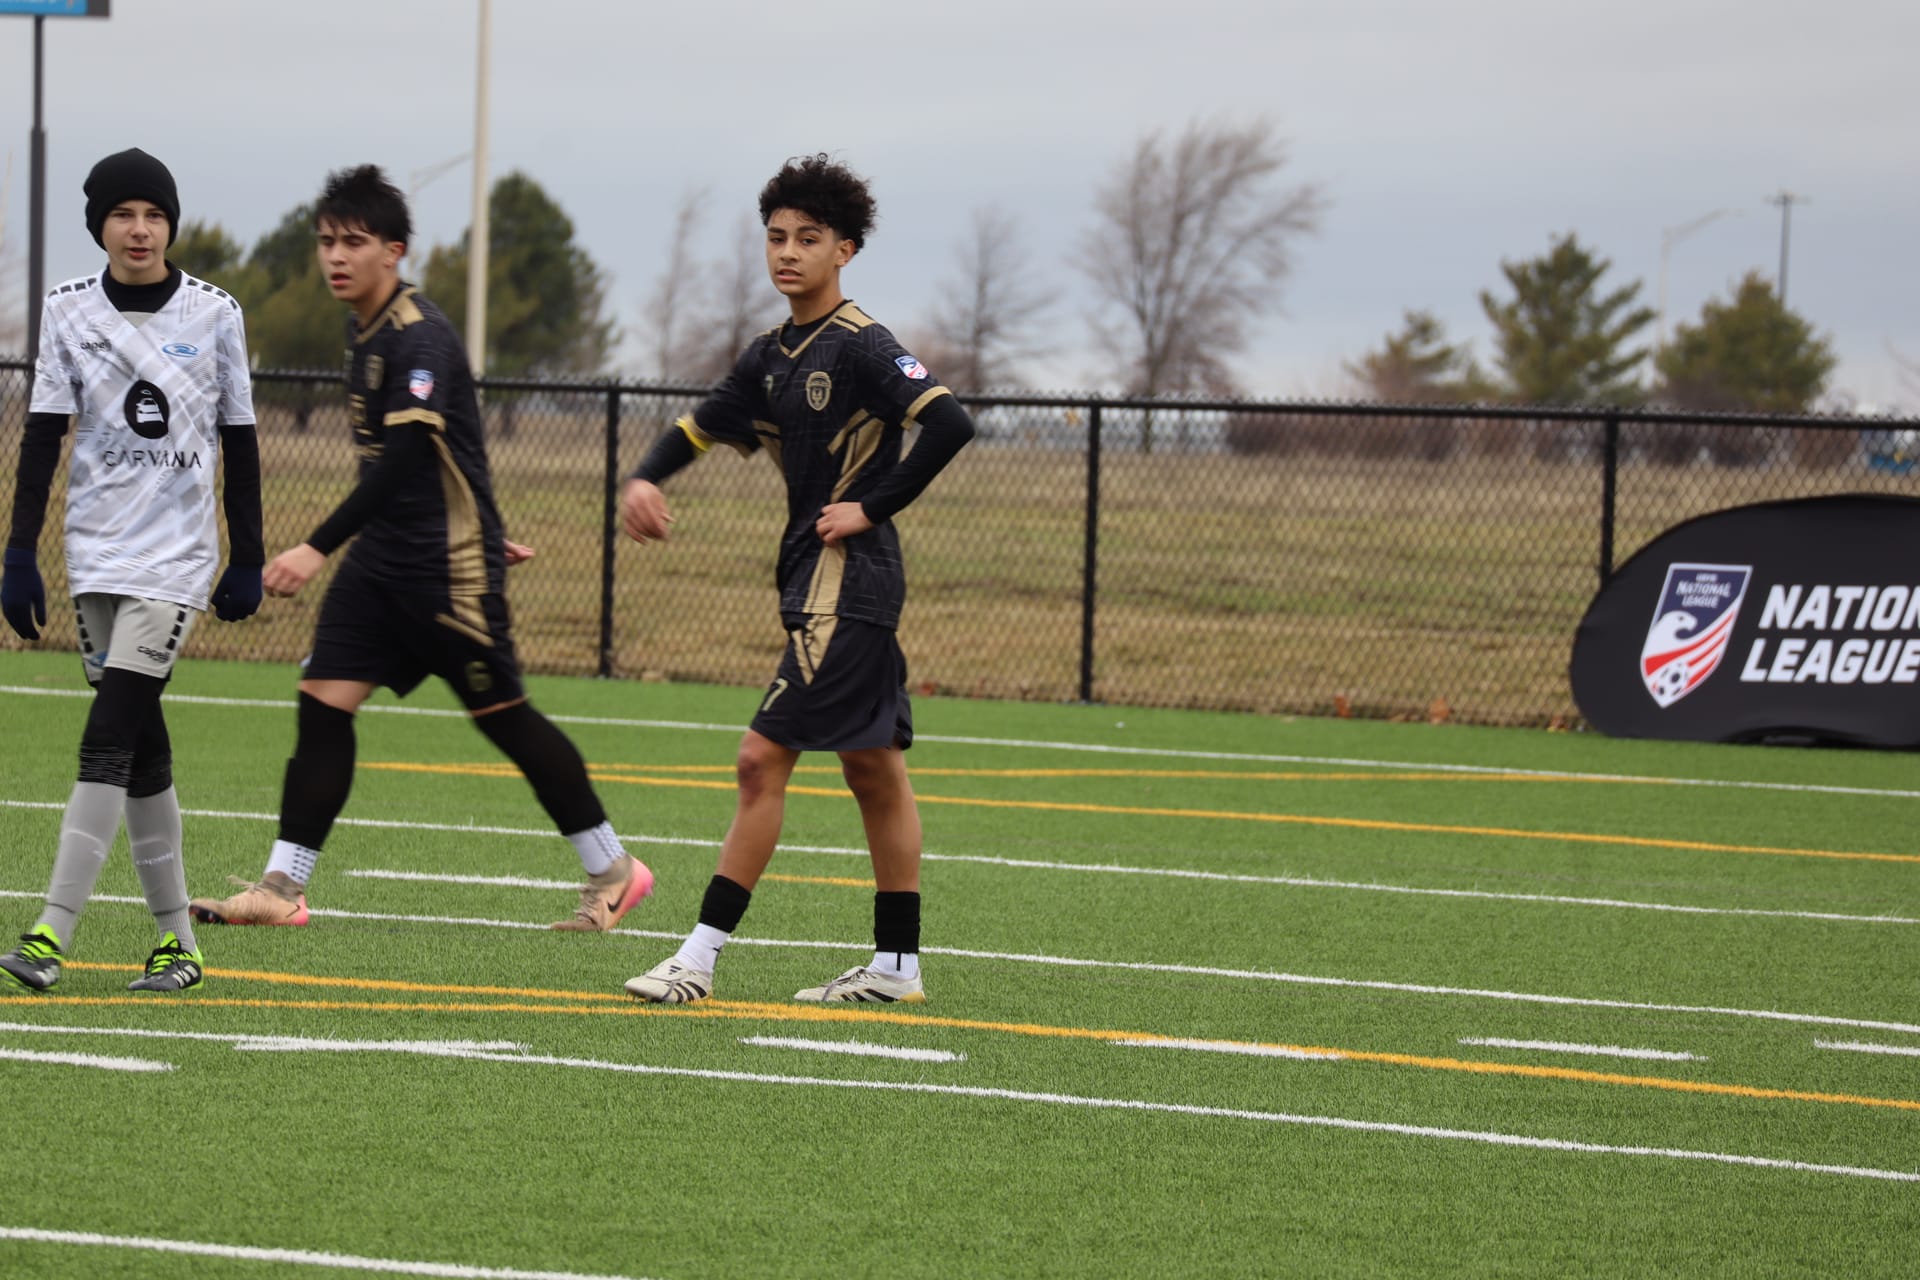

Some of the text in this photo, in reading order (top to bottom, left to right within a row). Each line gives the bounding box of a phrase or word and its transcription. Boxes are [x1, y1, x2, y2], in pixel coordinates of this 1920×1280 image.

[103, 448, 202, 469] CARVANA
[1676, 580, 1731, 598] NATIONAL
[1681, 595, 1720, 608] LEAGUE
[1739, 638, 1920, 684] LEAGUE
[762, 677, 788, 712] 7
